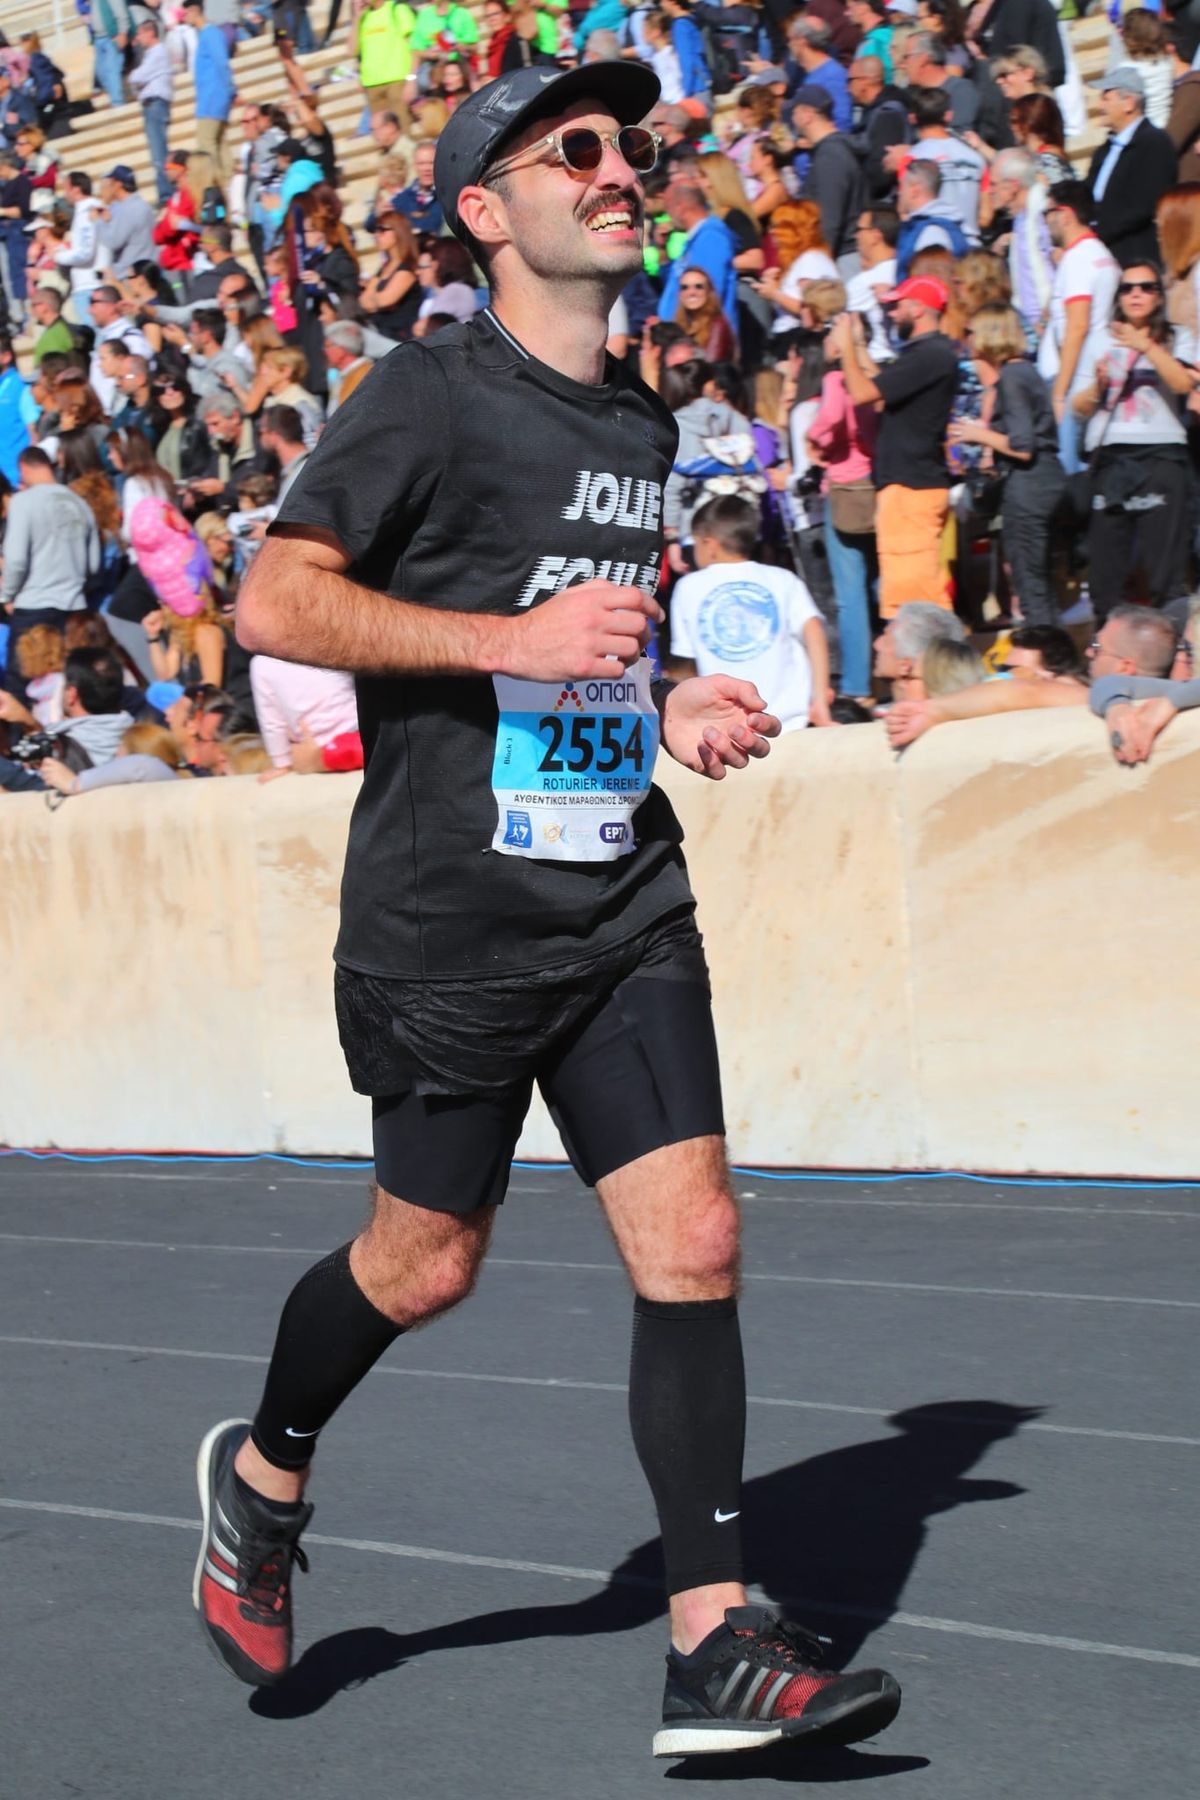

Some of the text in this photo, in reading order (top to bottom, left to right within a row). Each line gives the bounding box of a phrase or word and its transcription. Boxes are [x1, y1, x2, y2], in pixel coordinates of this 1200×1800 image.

[560, 470, 661, 532] JOLIE
[537, 715, 644, 773] 2554
[514, 794, 567, 805] ΑΥΘΕΝΤΙΚΟΣ
[569, 796, 617, 806] ΜΑΡΑΘΩΝΙΟΣ
[544, 778, 597, 790] ROTURIER
